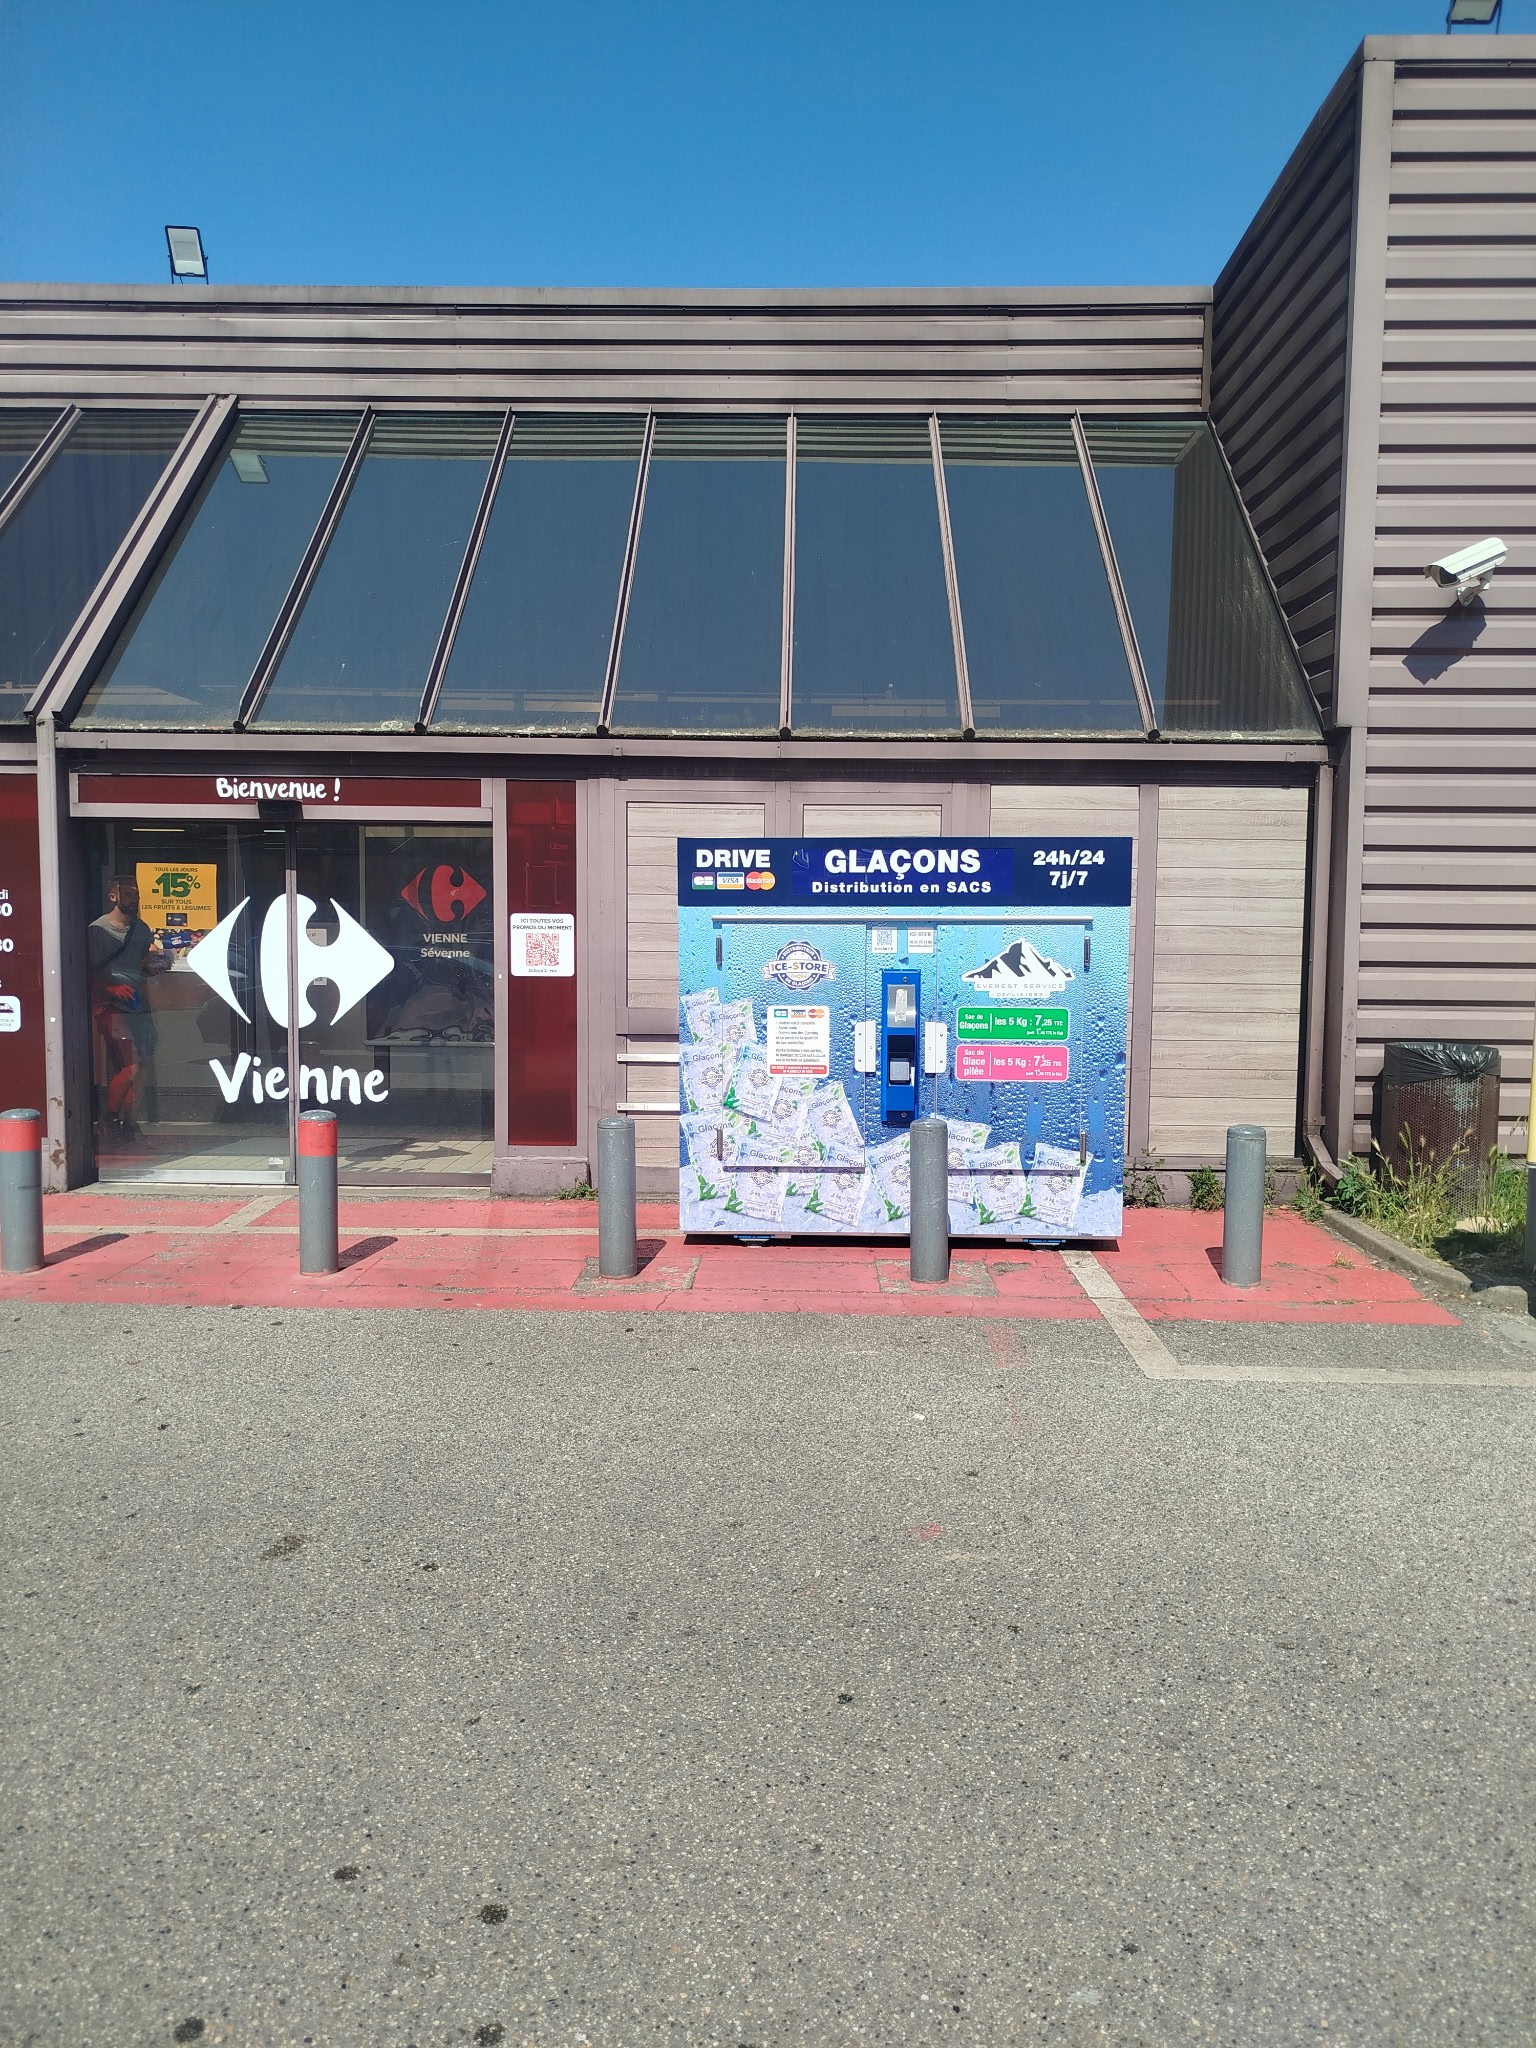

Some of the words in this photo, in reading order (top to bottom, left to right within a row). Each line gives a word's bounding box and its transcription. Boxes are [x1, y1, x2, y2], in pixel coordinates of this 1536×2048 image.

[216, 777, 327, 799] Bienvenue
[333, 777, 341, 802] !
[696, 849, 771, 868] DRIVE
[824, 848, 981, 880] GLAÇONS
[1033, 849, 1106, 866] 24h/24
[152, 872, 201, 898] -15%
[811, 881, 913, 893] Distribution
[919, 882, 940, 893] en
[946, 880, 992, 893] SACS
[1049, 870, 1089, 889] 7j/7
[0, 902, 13, 917] 0
[422, 933, 468, 943] VIENNE
[0, 938, 14, 953] 0
[420, 947, 471, 958] Sévenne
[770, 961, 828, 972] ICE-STORE
[959, 1021, 989, 1031] Glaçons
[994, 1017, 1007, 1026] les
[1008, 1017, 1015, 1026] 5
[1016, 1017, 1028, 1028] Kg
[962, 1057, 986, 1066] Glace
[993, 1057, 1006, 1066] les
[1007, 1057, 1013, 1066] 5
[1015, 1057, 1027, 1068] Kg
[208, 1052, 389, 1105] Vienne
[963, 1066, 984, 1077] pilée
